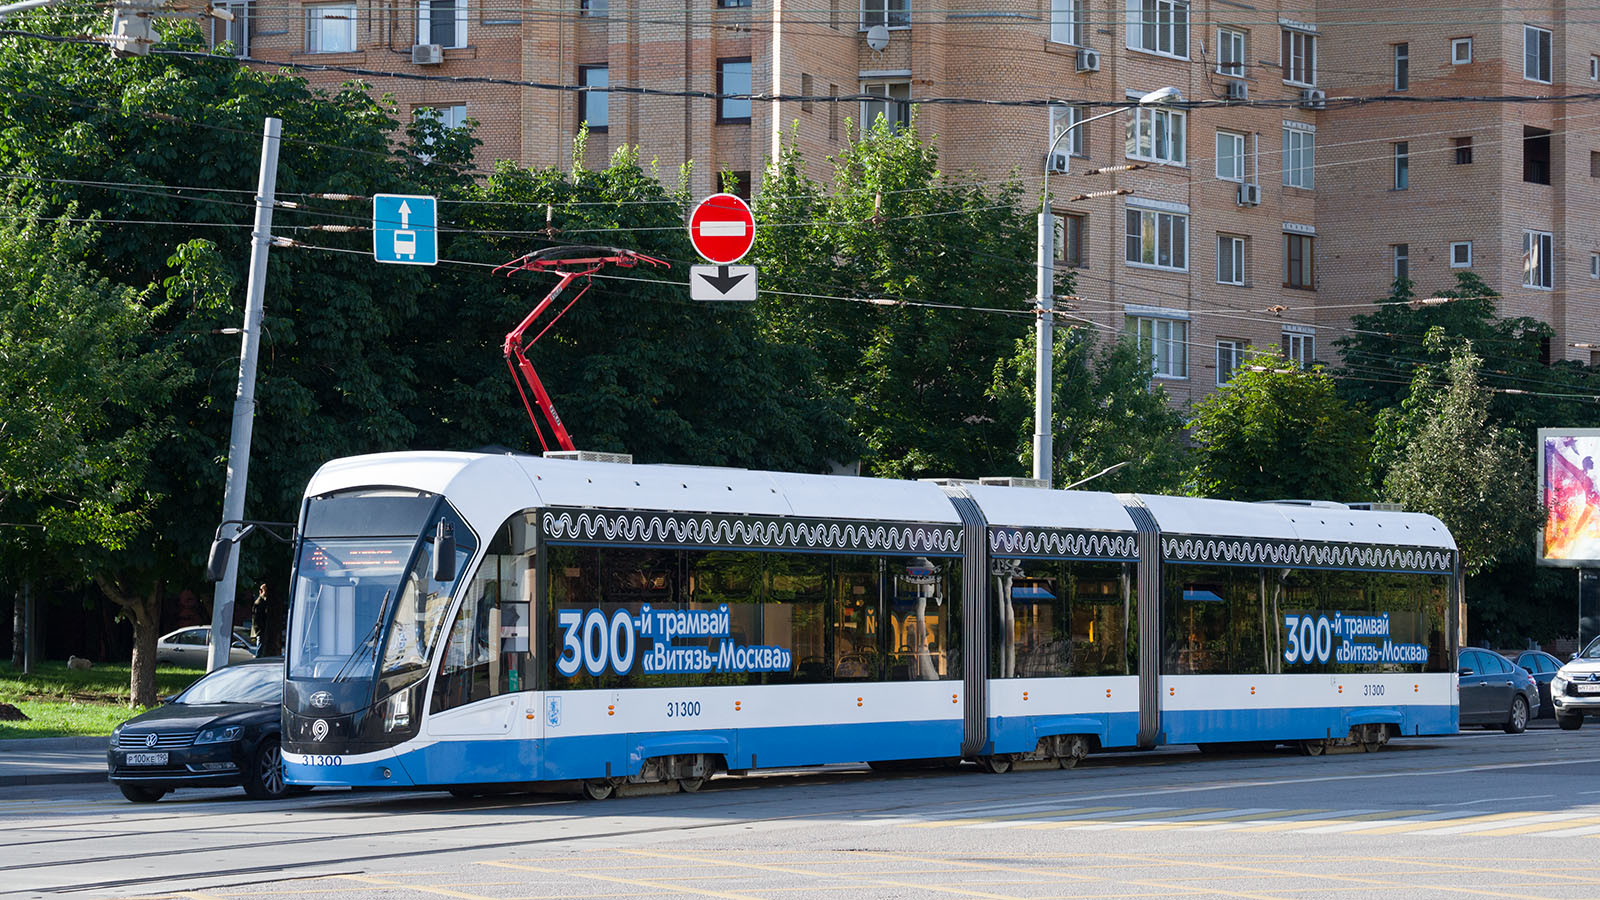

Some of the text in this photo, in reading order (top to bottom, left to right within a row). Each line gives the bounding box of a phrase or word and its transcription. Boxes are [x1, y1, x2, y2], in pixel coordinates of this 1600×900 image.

[557, 605, 729, 674] 300-й трамвай
[1284, 612, 1389, 662] 300-й трамвай
[643, 641, 791, 672] «Витязь-Москва»
[1336, 640, 1428, 662] «Витязь-Москва»
[1363, 684, 1385, 696] 31300
[667, 701, 701, 717] 31300
[302, 755, 343, 767] 31300
